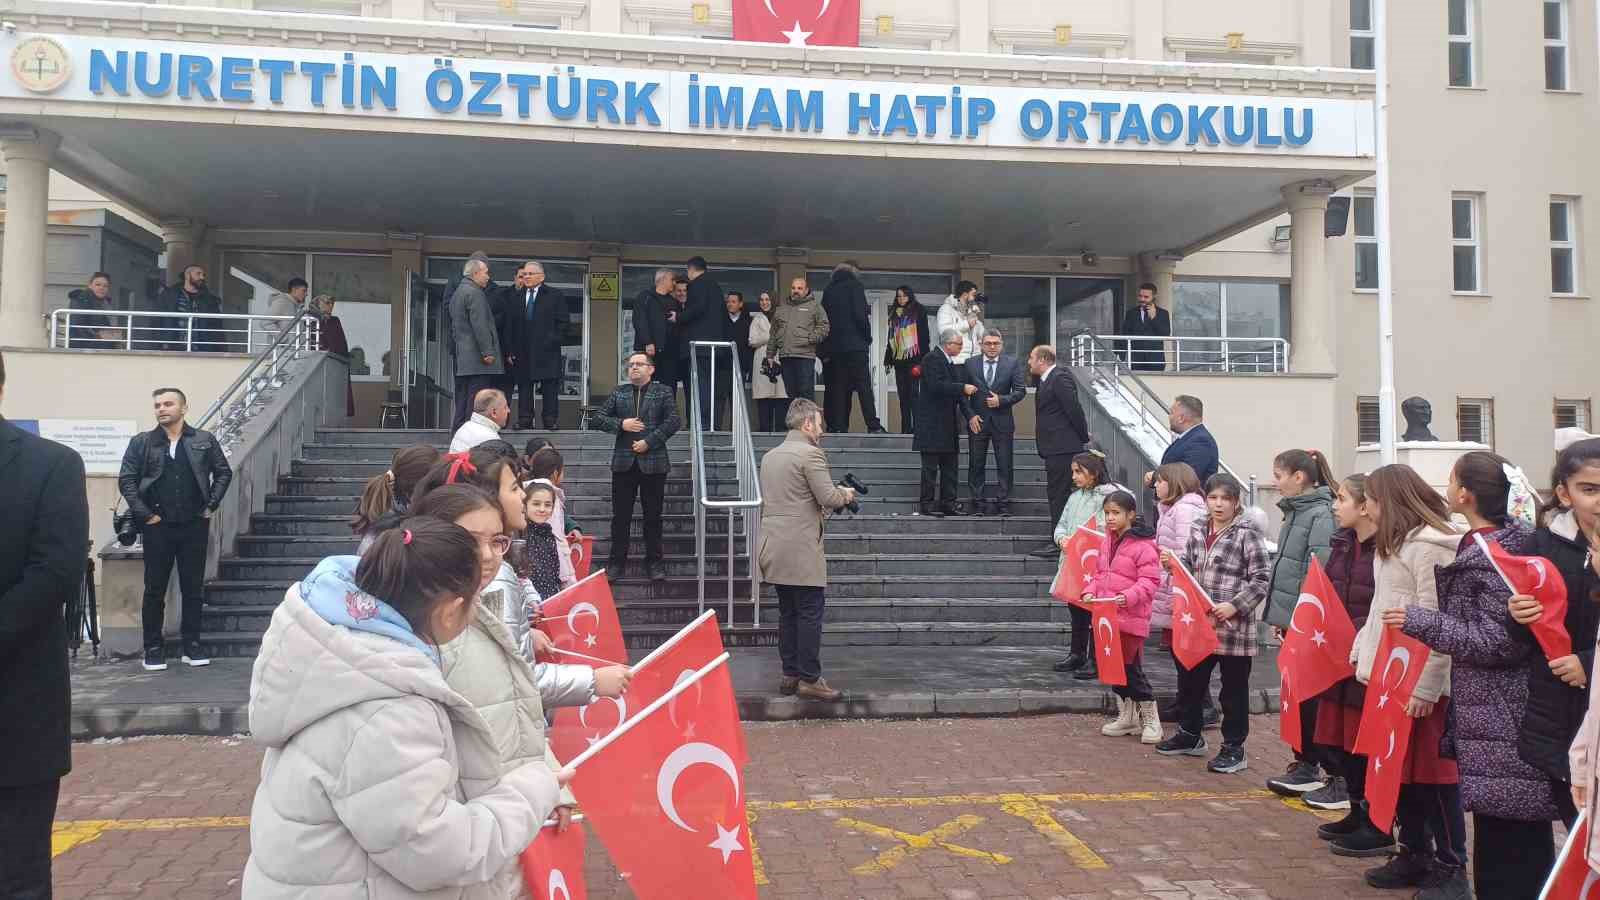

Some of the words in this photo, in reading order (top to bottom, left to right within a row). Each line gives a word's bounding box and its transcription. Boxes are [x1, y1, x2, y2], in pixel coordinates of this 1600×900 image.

[89, 49, 397, 109] NURETTİN
[426, 58, 661, 126] ÖZTÜRK
[688, 73, 824, 131] İMAM
[849, 85, 996, 138] HATİP
[1020, 98, 1313, 146] ORTAOKULU
